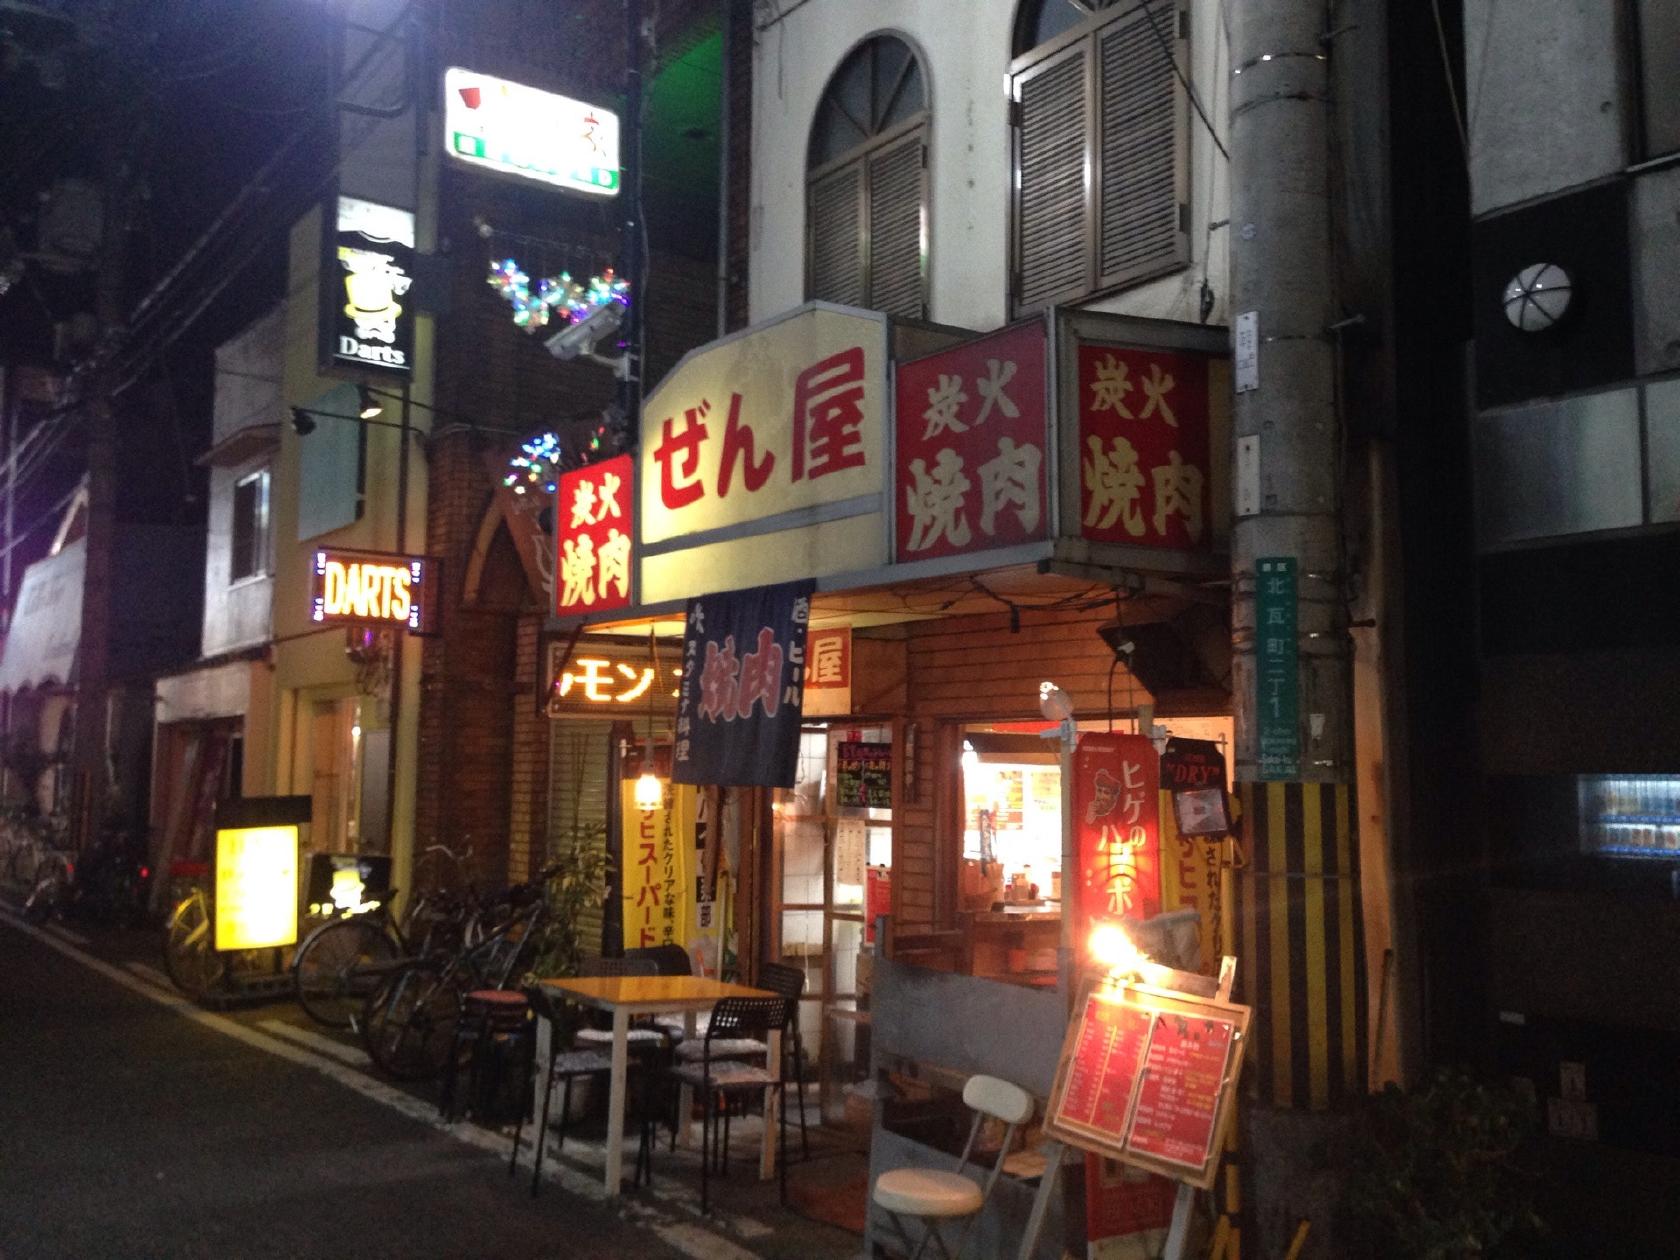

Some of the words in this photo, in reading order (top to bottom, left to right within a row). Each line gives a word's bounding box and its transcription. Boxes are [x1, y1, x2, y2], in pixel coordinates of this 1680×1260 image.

[339, 335, 406, 365] Darts
[1089, 353, 1179, 427] 炭火
[653, 346, 867, 511] ぜん屋
[922, 358, 1021, 441] 炭火
[570, 472, 622, 529] 炭火
[906, 436, 1042, 551] 焼肉
[1083, 434, 1204, 544] 焼肉
[324, 562, 411, 620] DARTS
[560, 528, 632, 607] 焼肉
[698, 626, 783, 723] 焼肉
[804, 637, 843, 684] 屋
[1122, 760, 1147, 848] ヒゲの
